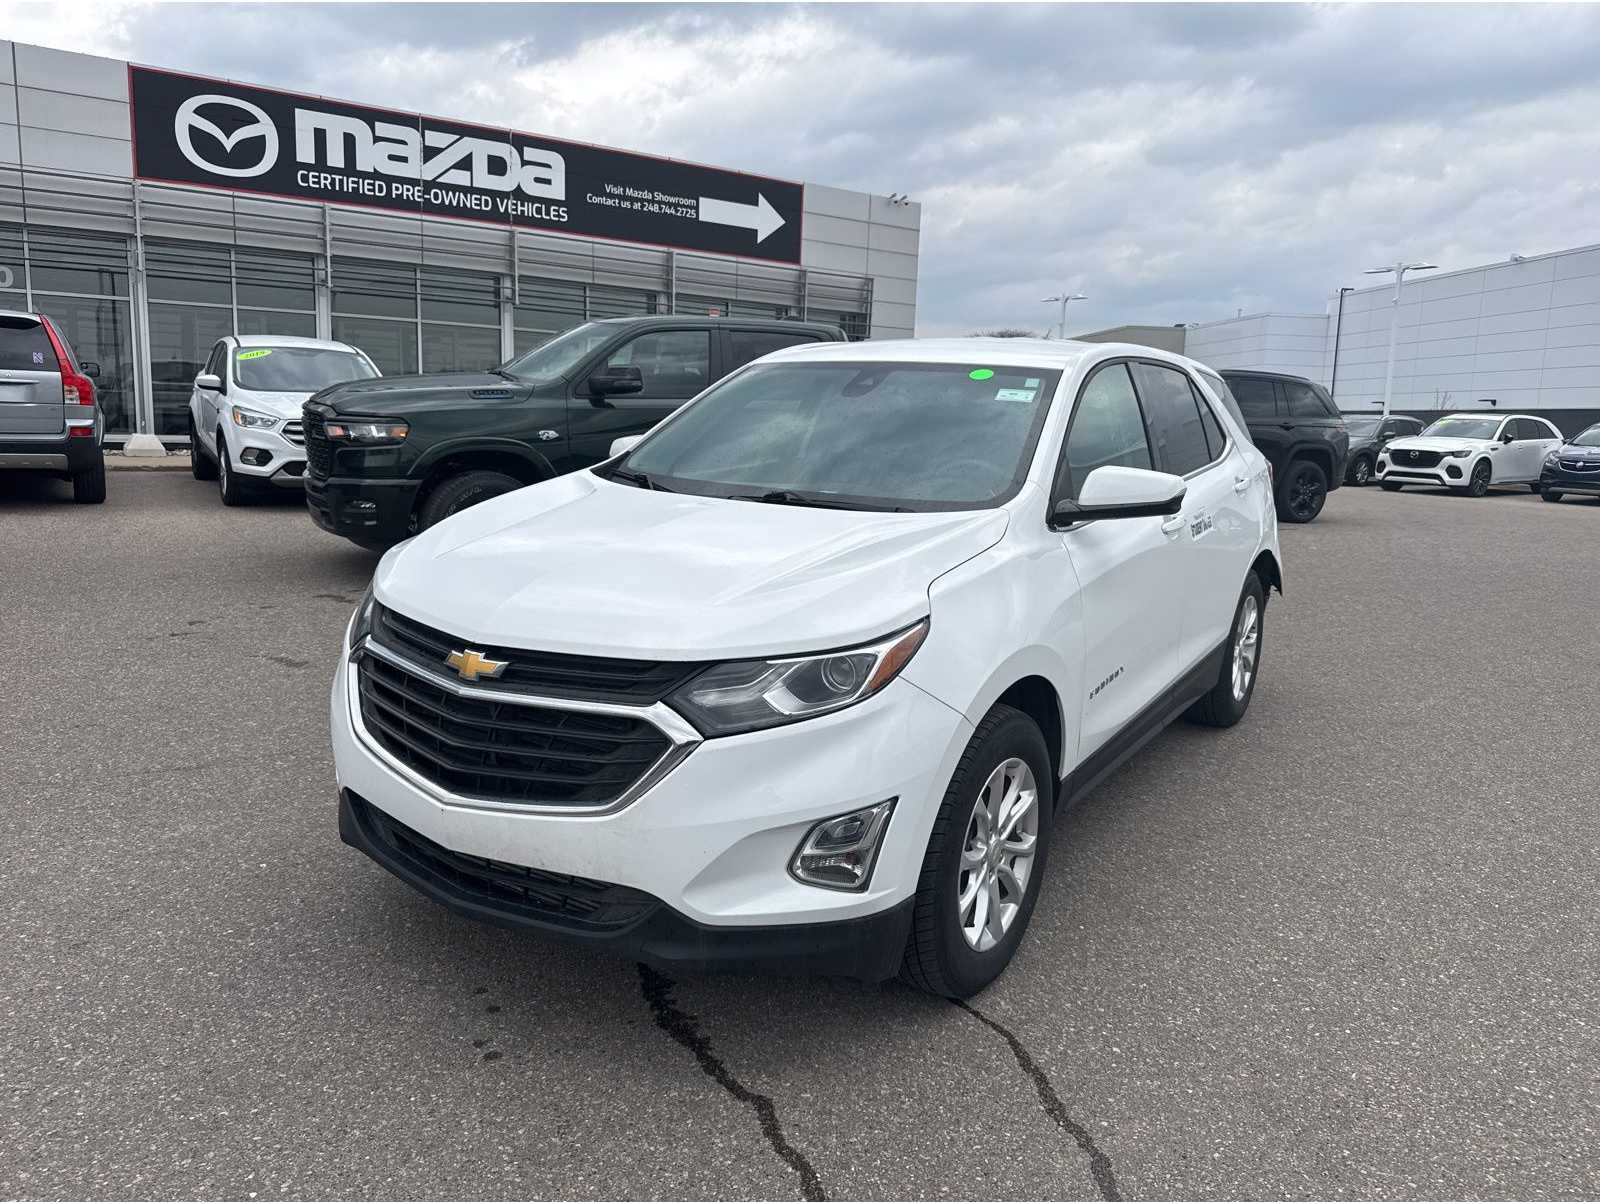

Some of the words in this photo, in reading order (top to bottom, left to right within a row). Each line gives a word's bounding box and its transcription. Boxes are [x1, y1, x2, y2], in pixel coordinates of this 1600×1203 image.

[297, 170, 387, 197] CERTIFIED
[392, 183, 492, 211] PRE-OWNED
[496, 199, 569, 222] VEHICLES
[586, 193, 620, 207] Contact
[620, 200, 631, 209] us
[632, 202, 642, 210] at
[643, 202, 697, 219] 248.744.2725
[604, 183, 624, 195] Visit
[625, 187, 653, 200] Mazda
[654, 191, 697, 207] Showroom
